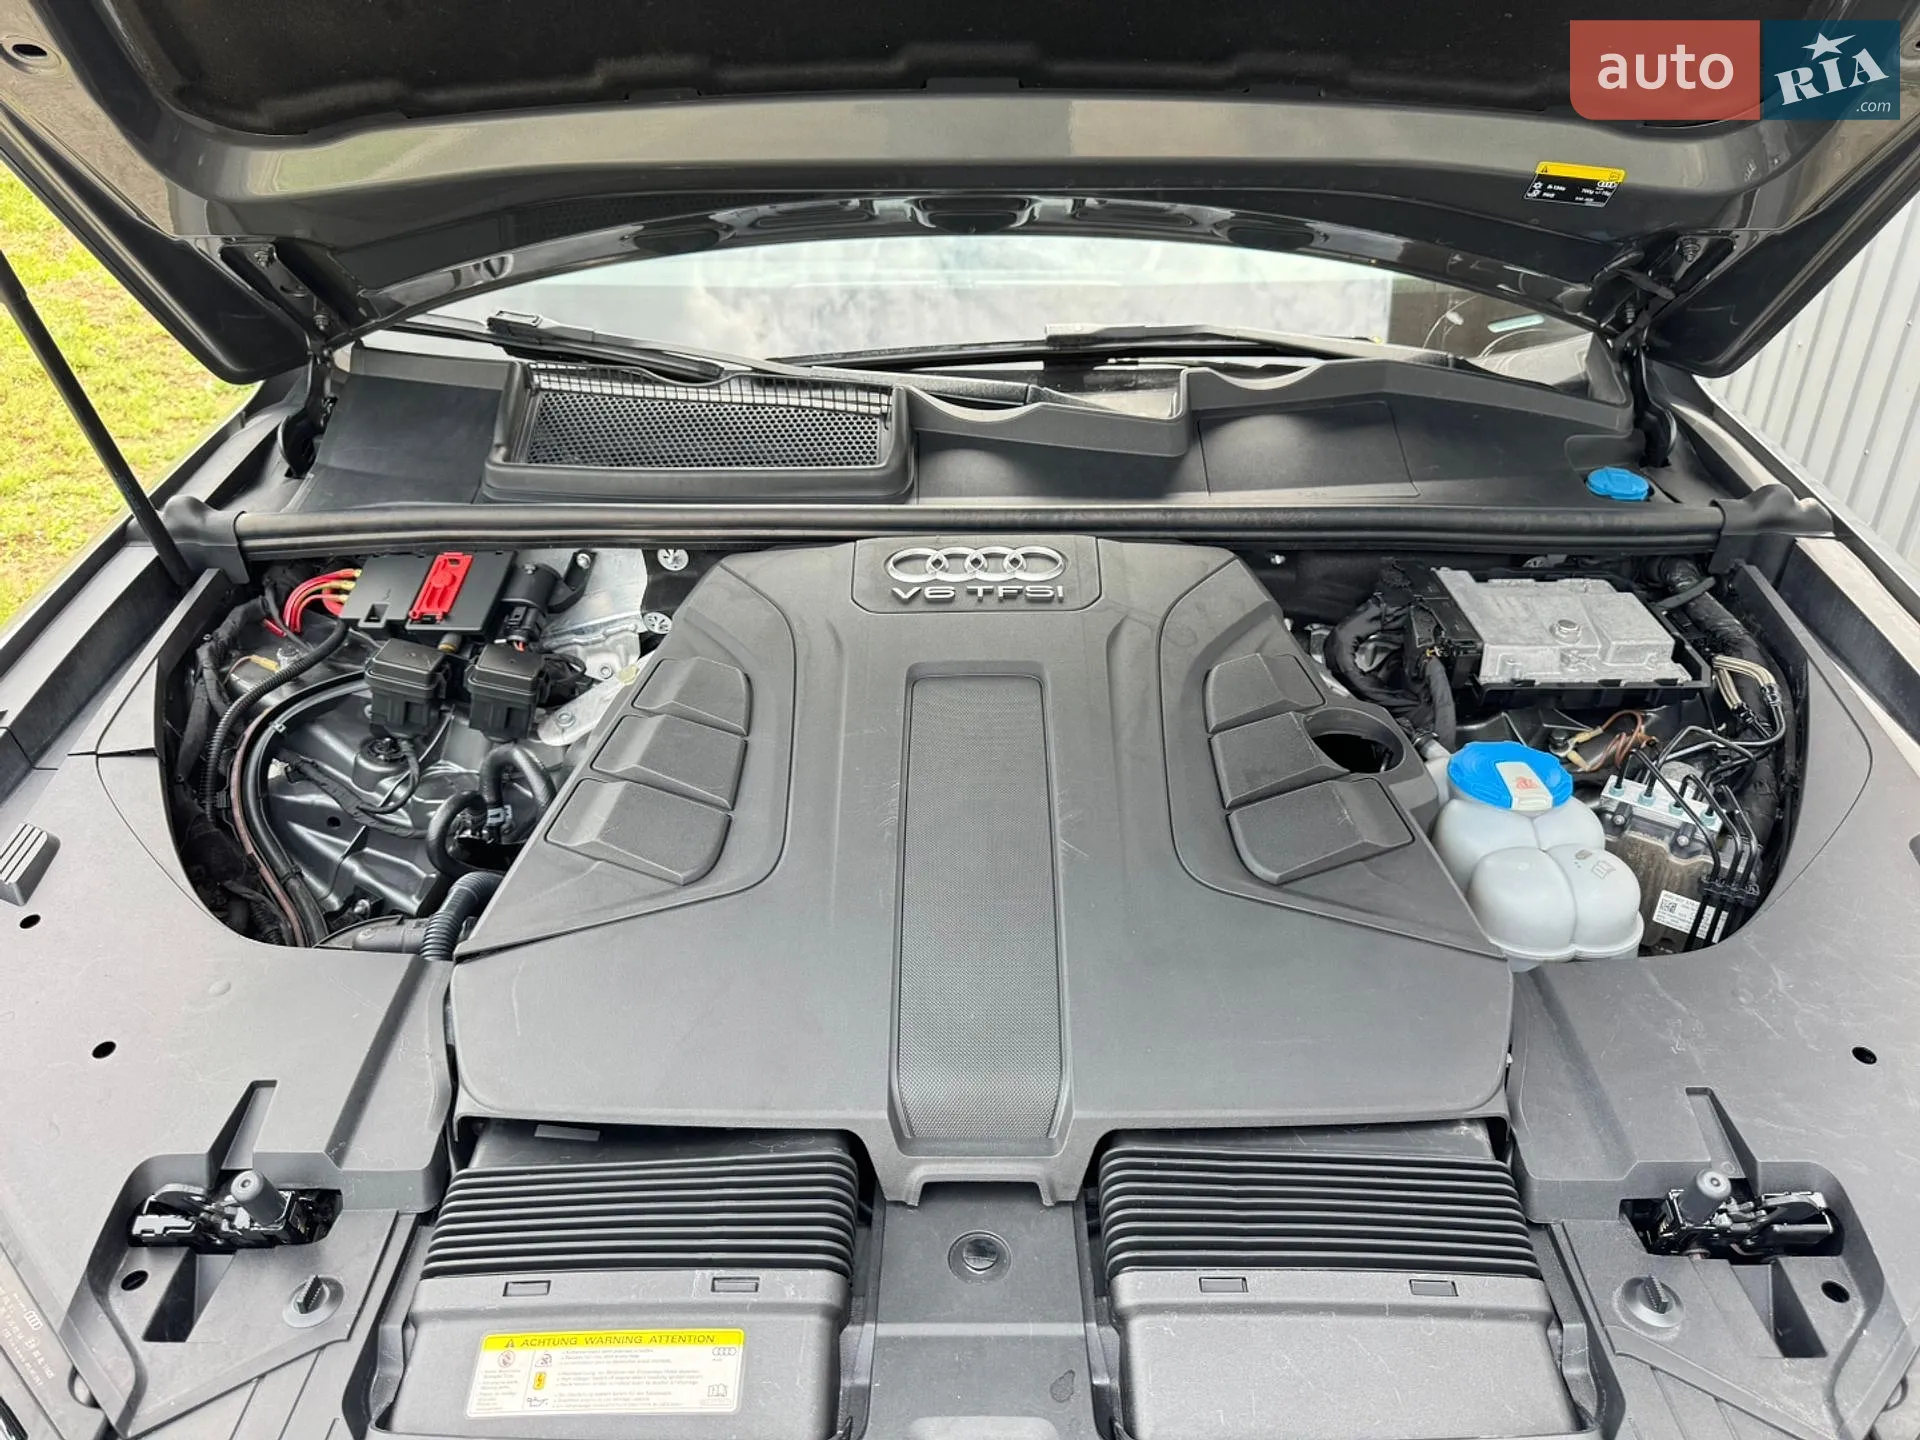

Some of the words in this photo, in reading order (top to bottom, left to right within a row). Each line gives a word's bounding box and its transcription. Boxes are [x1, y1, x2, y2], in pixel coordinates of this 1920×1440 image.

[891, 586, 956, 604] V6
[966, 585, 1065, 602] TFSI
[520, 1337, 578, 1348] ACHTUNG
[584, 1335, 643, 1346] WARNING
[649, 1334, 716, 1344] ATTENTION
